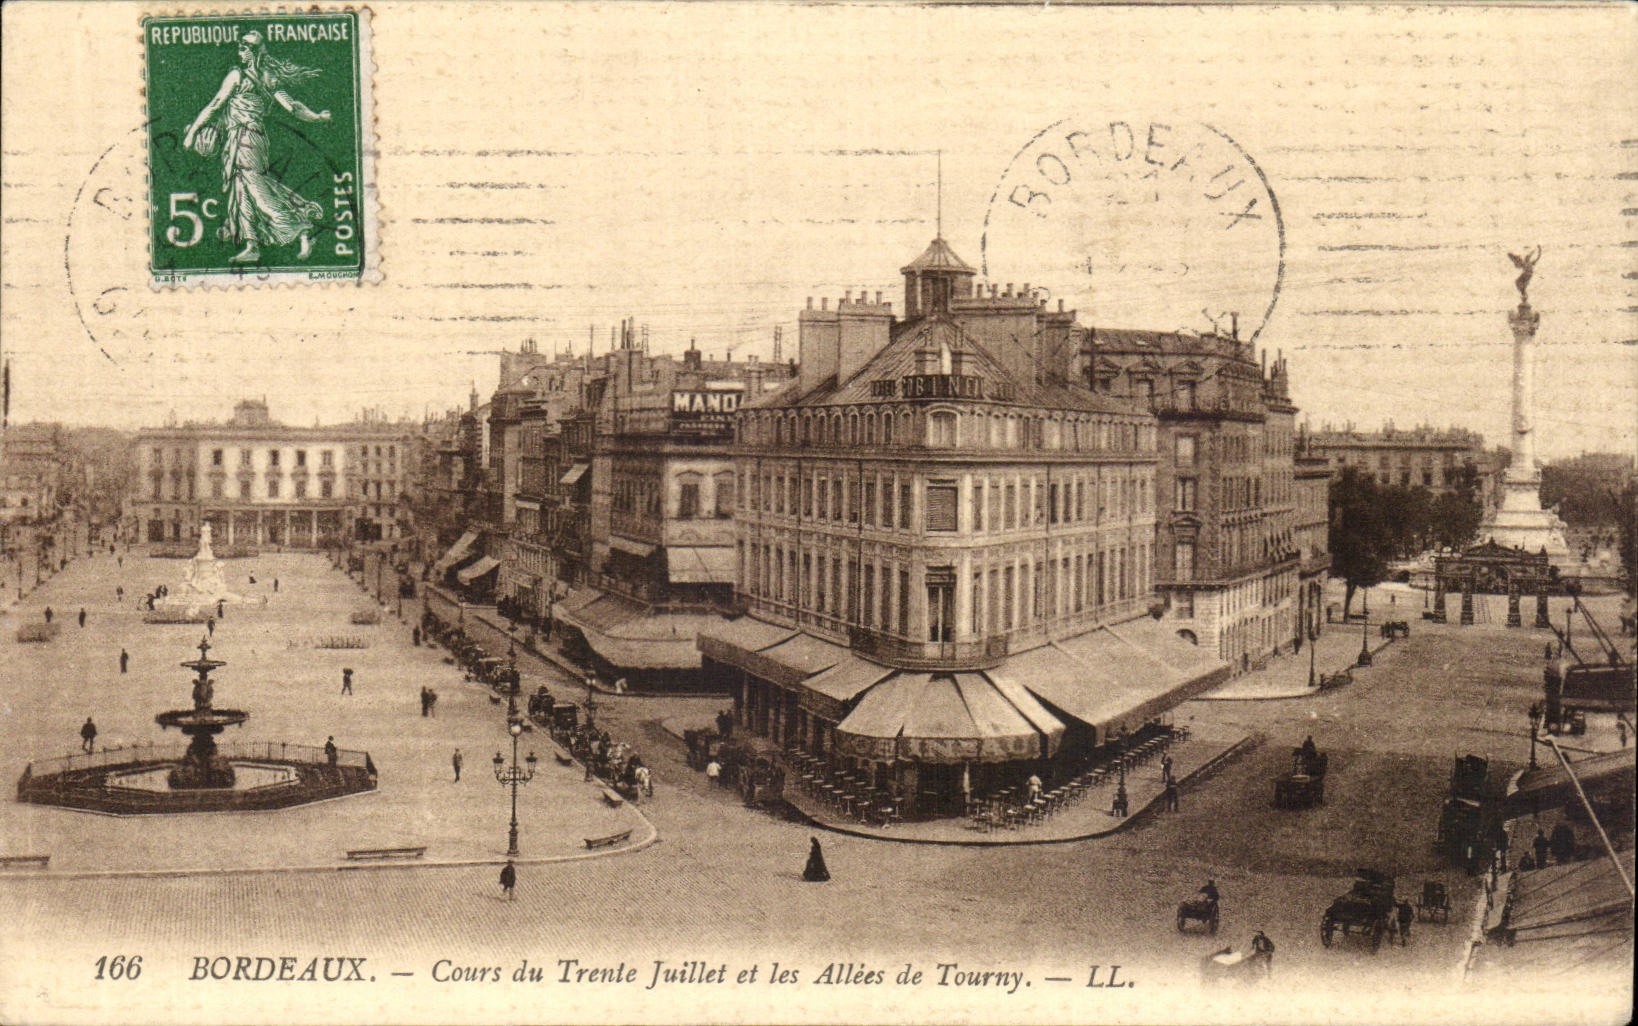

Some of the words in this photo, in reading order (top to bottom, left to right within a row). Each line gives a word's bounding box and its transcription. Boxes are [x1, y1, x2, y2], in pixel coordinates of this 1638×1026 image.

[151, 26, 239, 46] REPUBLIQUE
[267, 22, 348, 44] FRANÇAISE
[333, 171, 354, 255] POSTES
[673, 391, 744, 412] MANO
